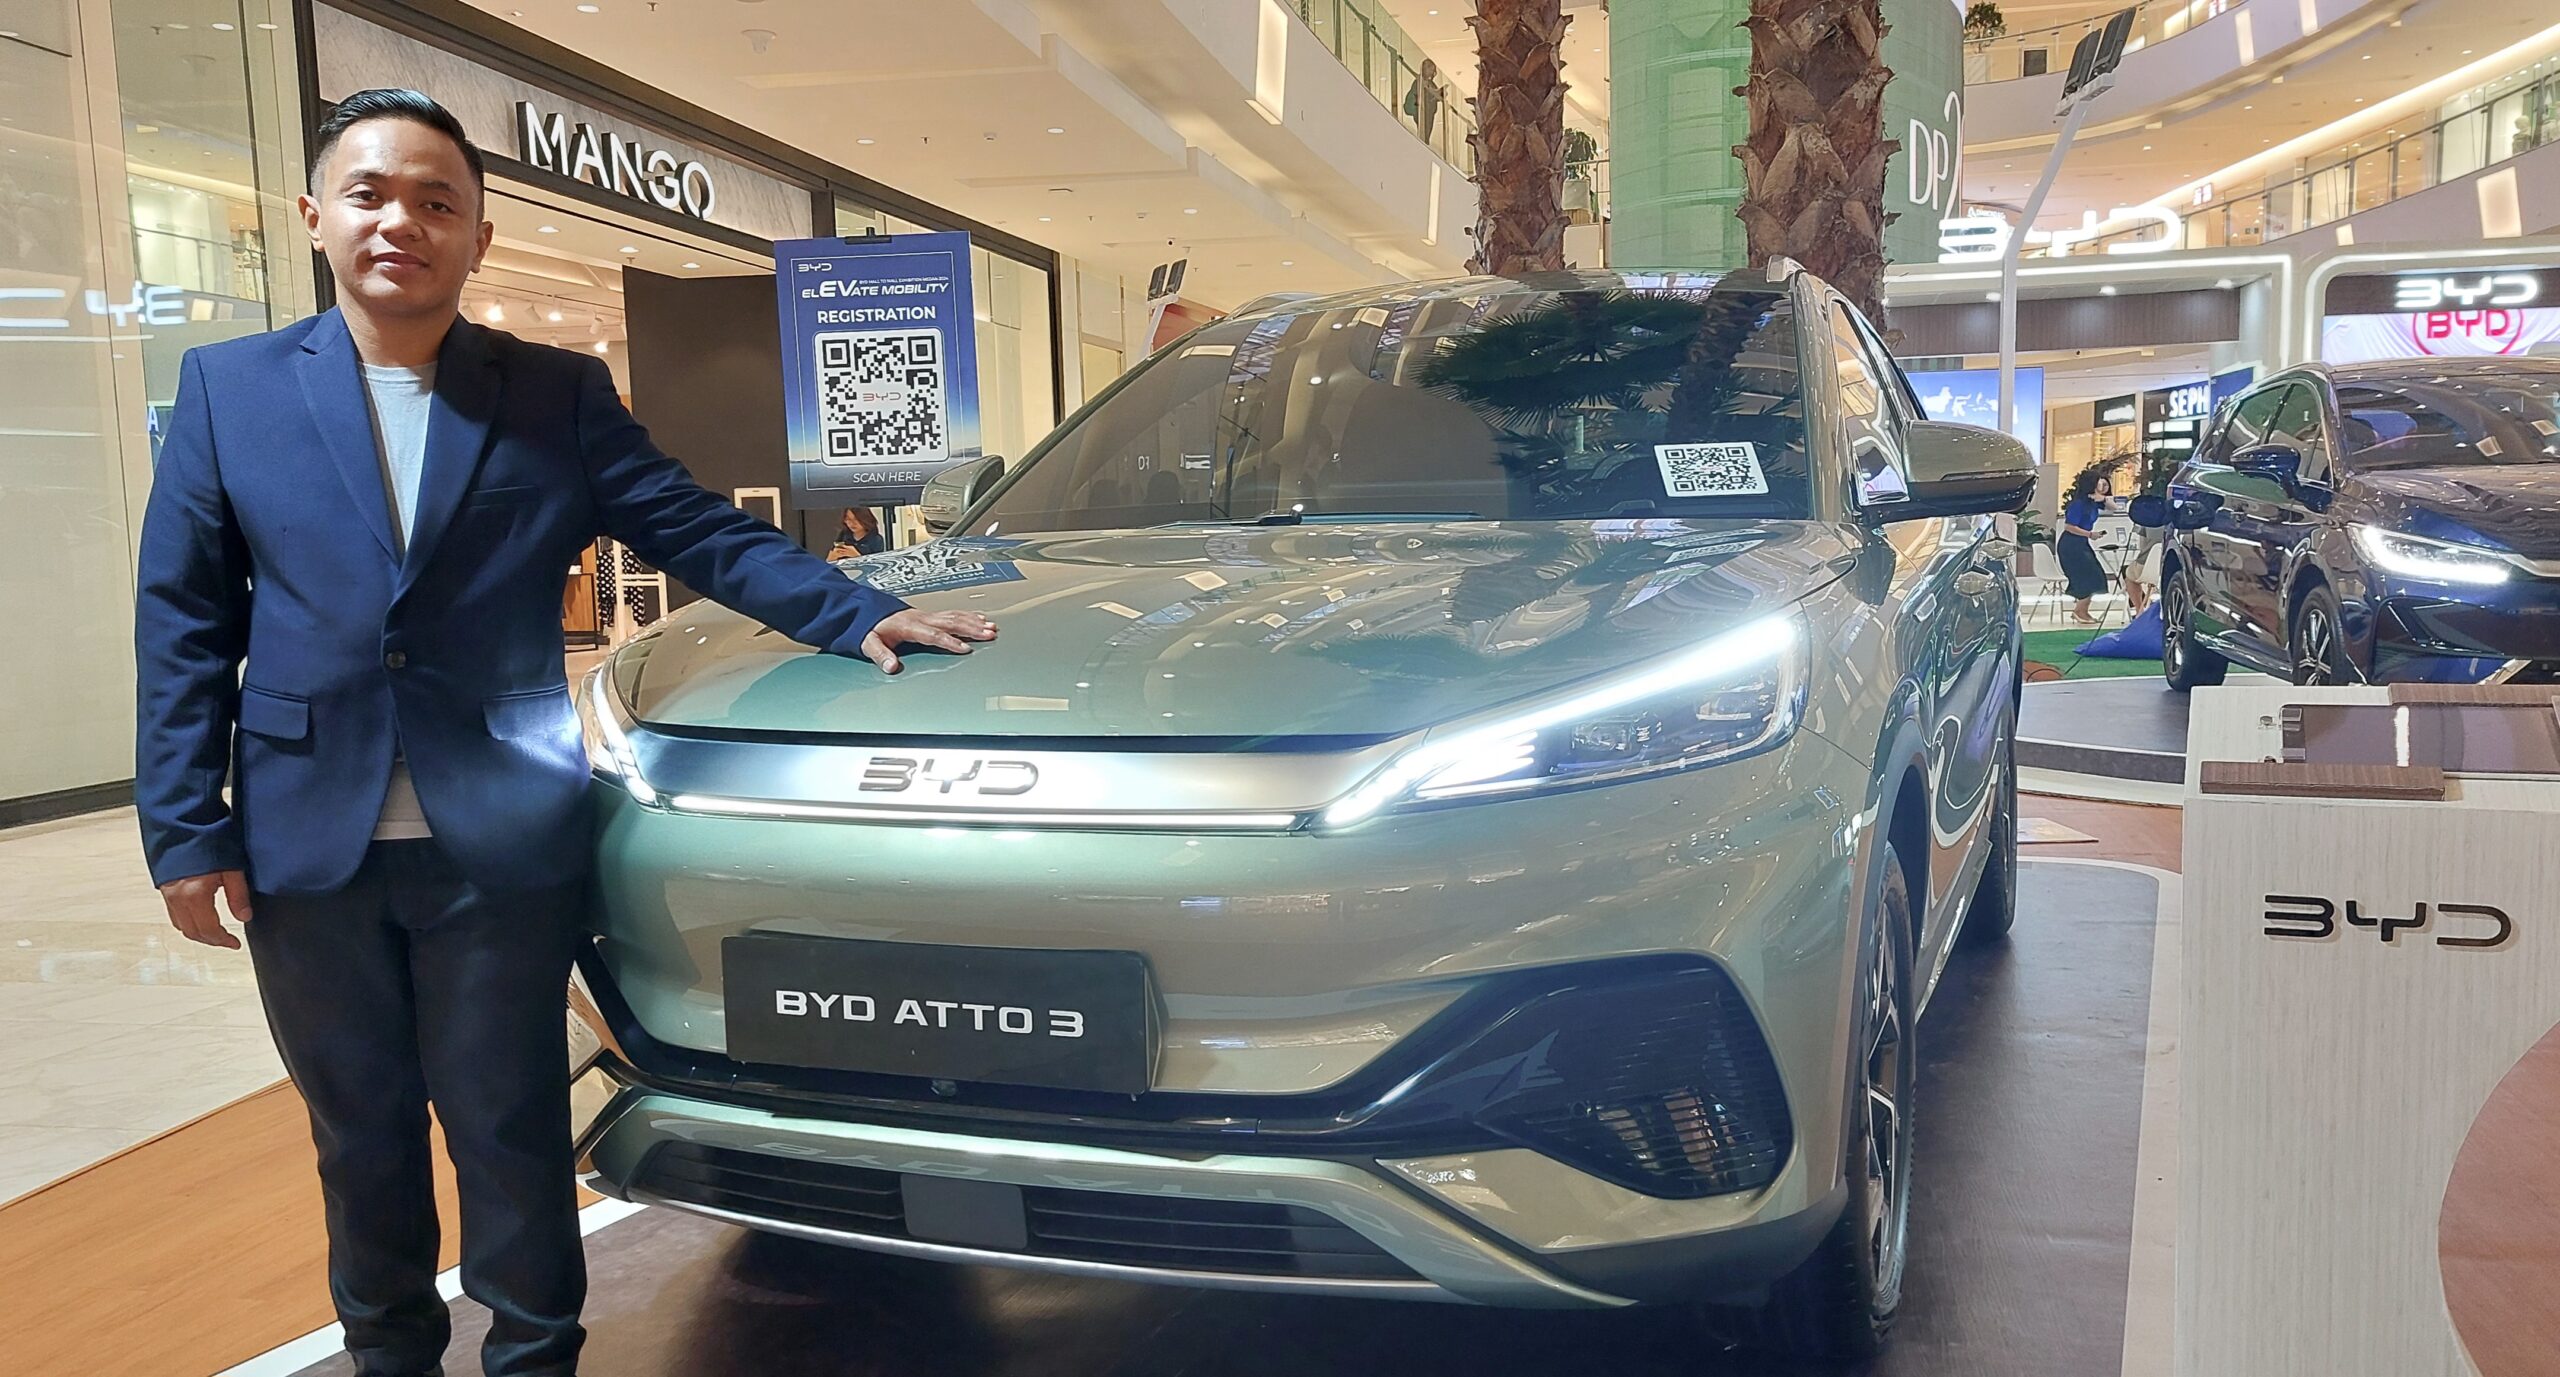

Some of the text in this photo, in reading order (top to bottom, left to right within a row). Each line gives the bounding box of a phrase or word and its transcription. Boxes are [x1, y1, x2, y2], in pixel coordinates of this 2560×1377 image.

[516, 100, 716, 220] MANGO
[1938, 206, 2182, 264] BYD
[798, 262, 832, 272] BYD
[881, 282, 949, 296] MOBILITY
[2395, 273, 2538, 308] BYD
[817, 306, 937, 324] REGISTRATION
[2427, 309, 2510, 339] BYD
[862, 391, 902, 402] BYD
[853, 470, 921, 484] SCAN HERE
[858, 756, 1039, 796] BYD
[2264, 894, 2512, 947] BYD
[775, 989, 1085, 1038] BYD ATTO 3
